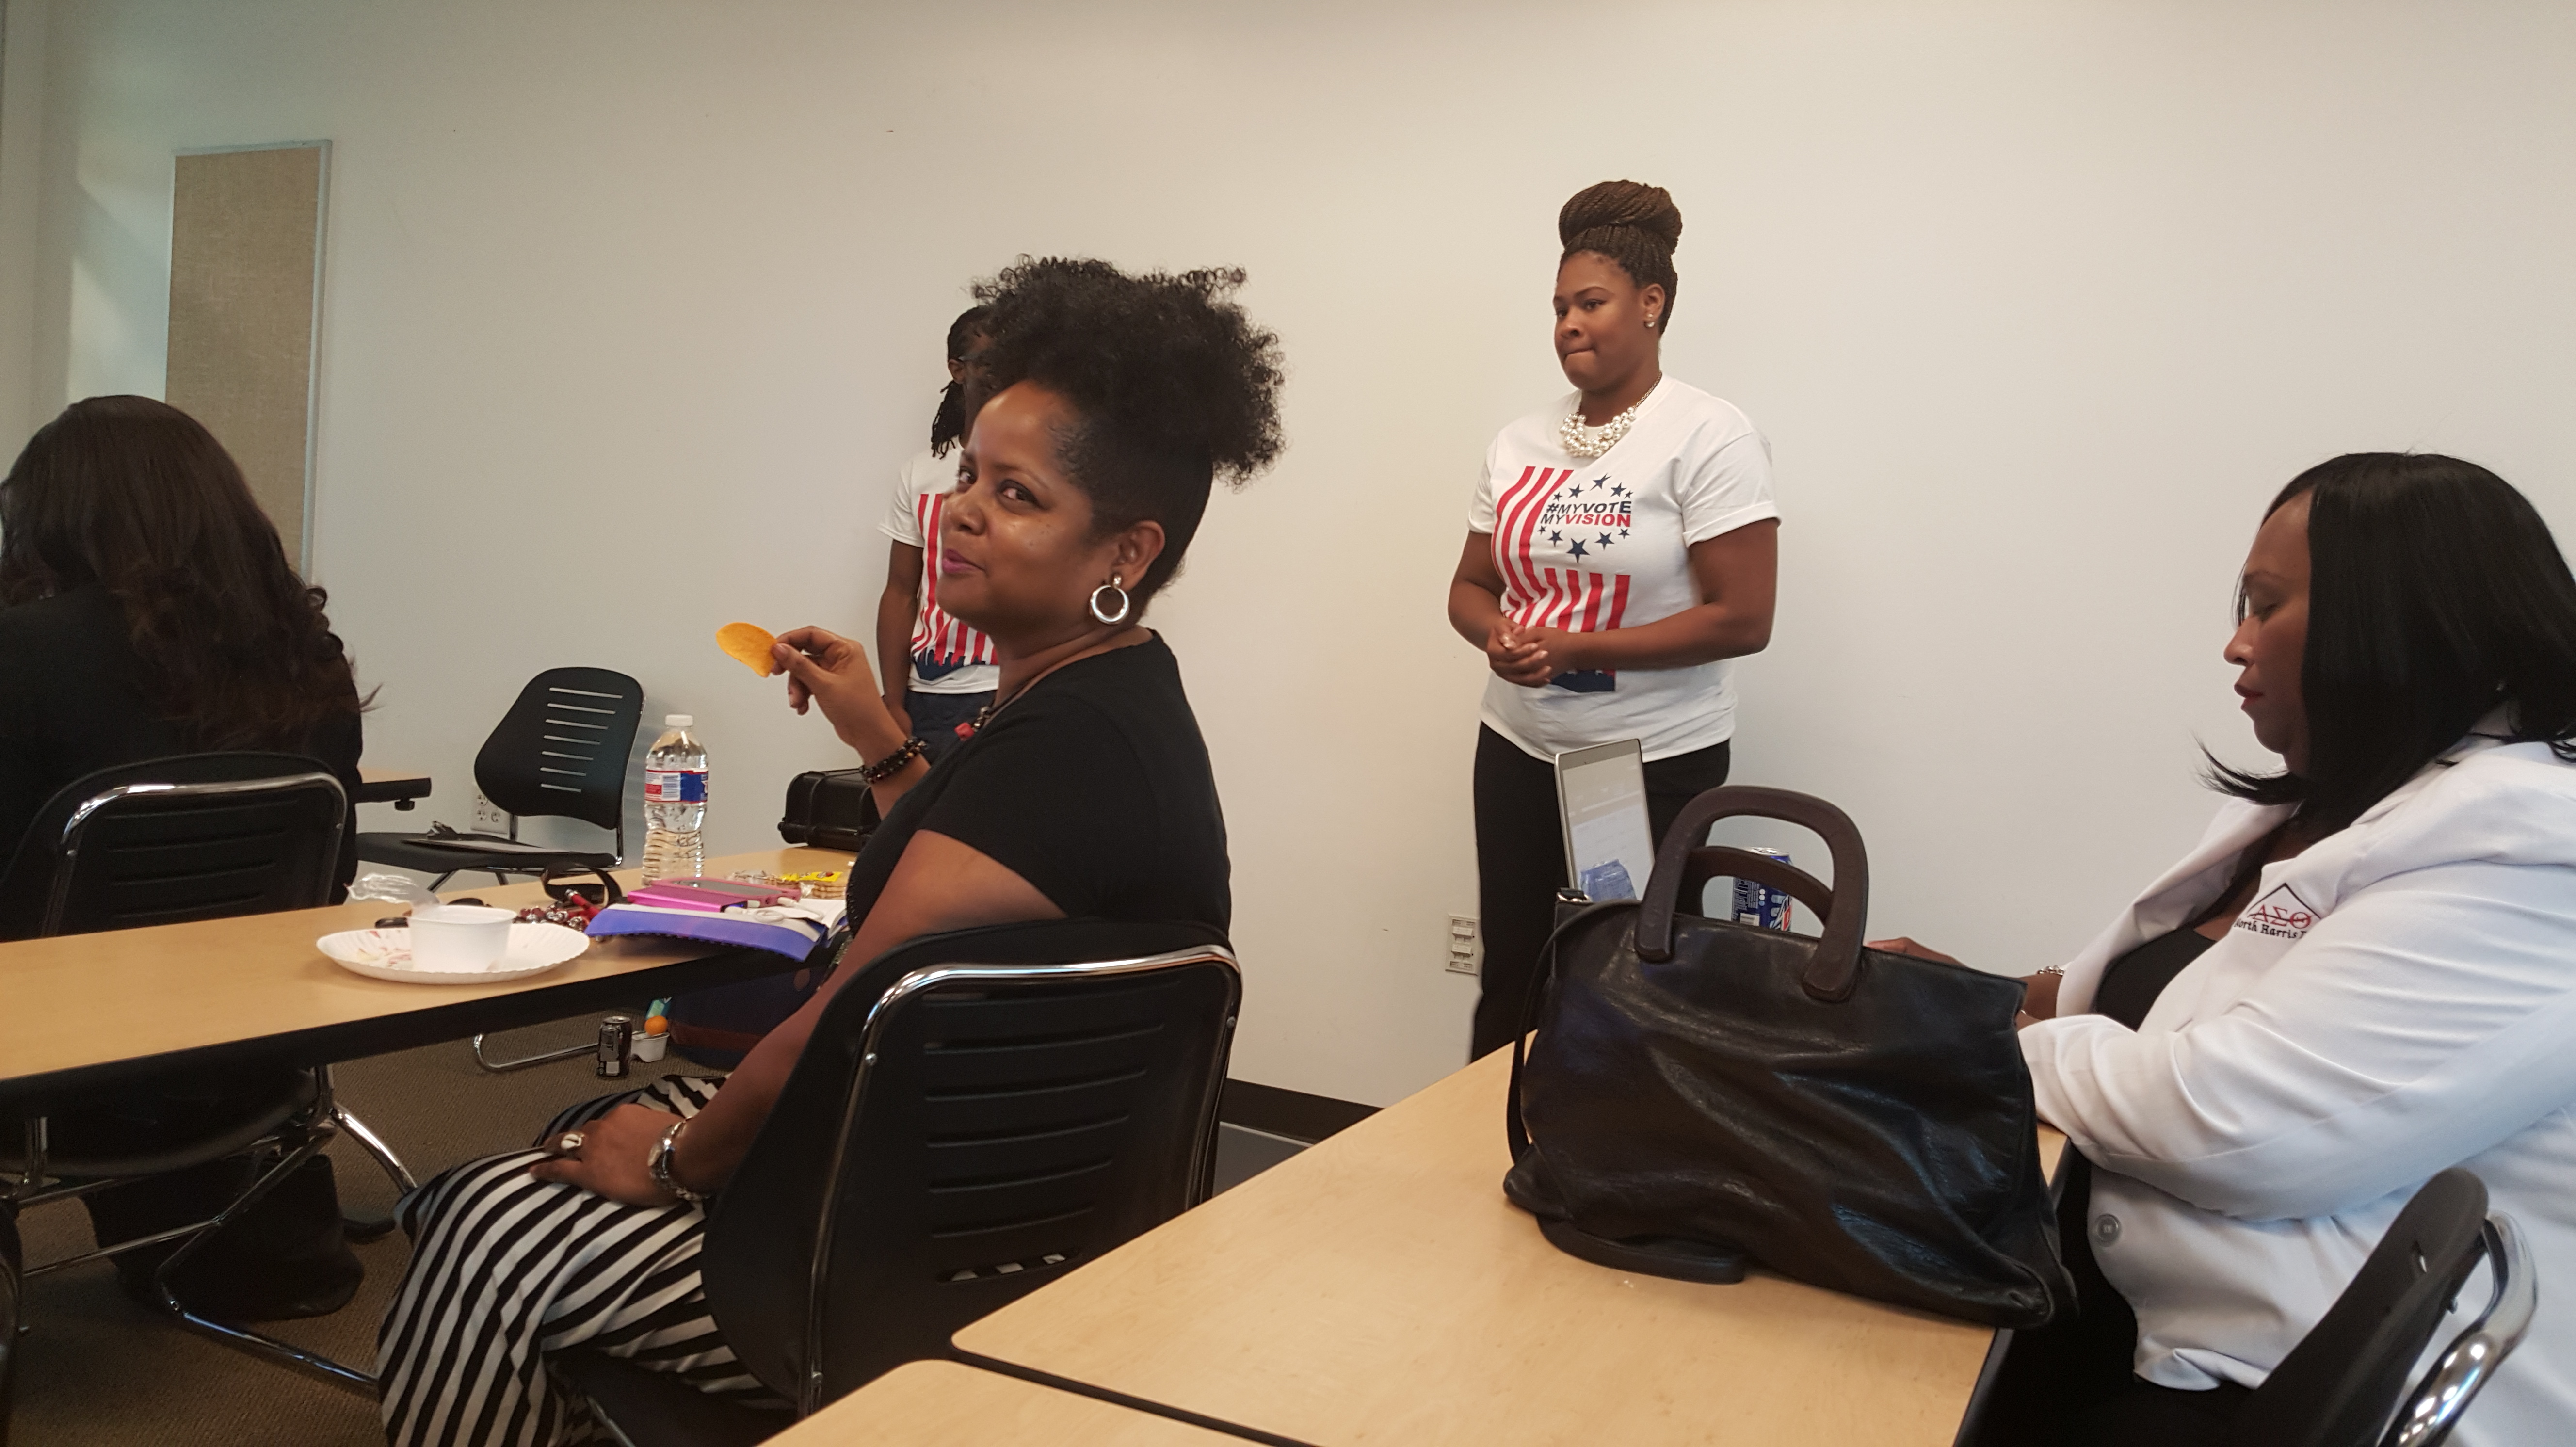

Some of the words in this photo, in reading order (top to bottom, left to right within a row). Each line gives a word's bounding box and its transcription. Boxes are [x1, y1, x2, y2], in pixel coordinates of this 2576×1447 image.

[1546, 501, 1632, 514] #MYVOTE
[1540, 514, 1631, 528] MYVISION
[2260, 923, 2298, 939] Harris
